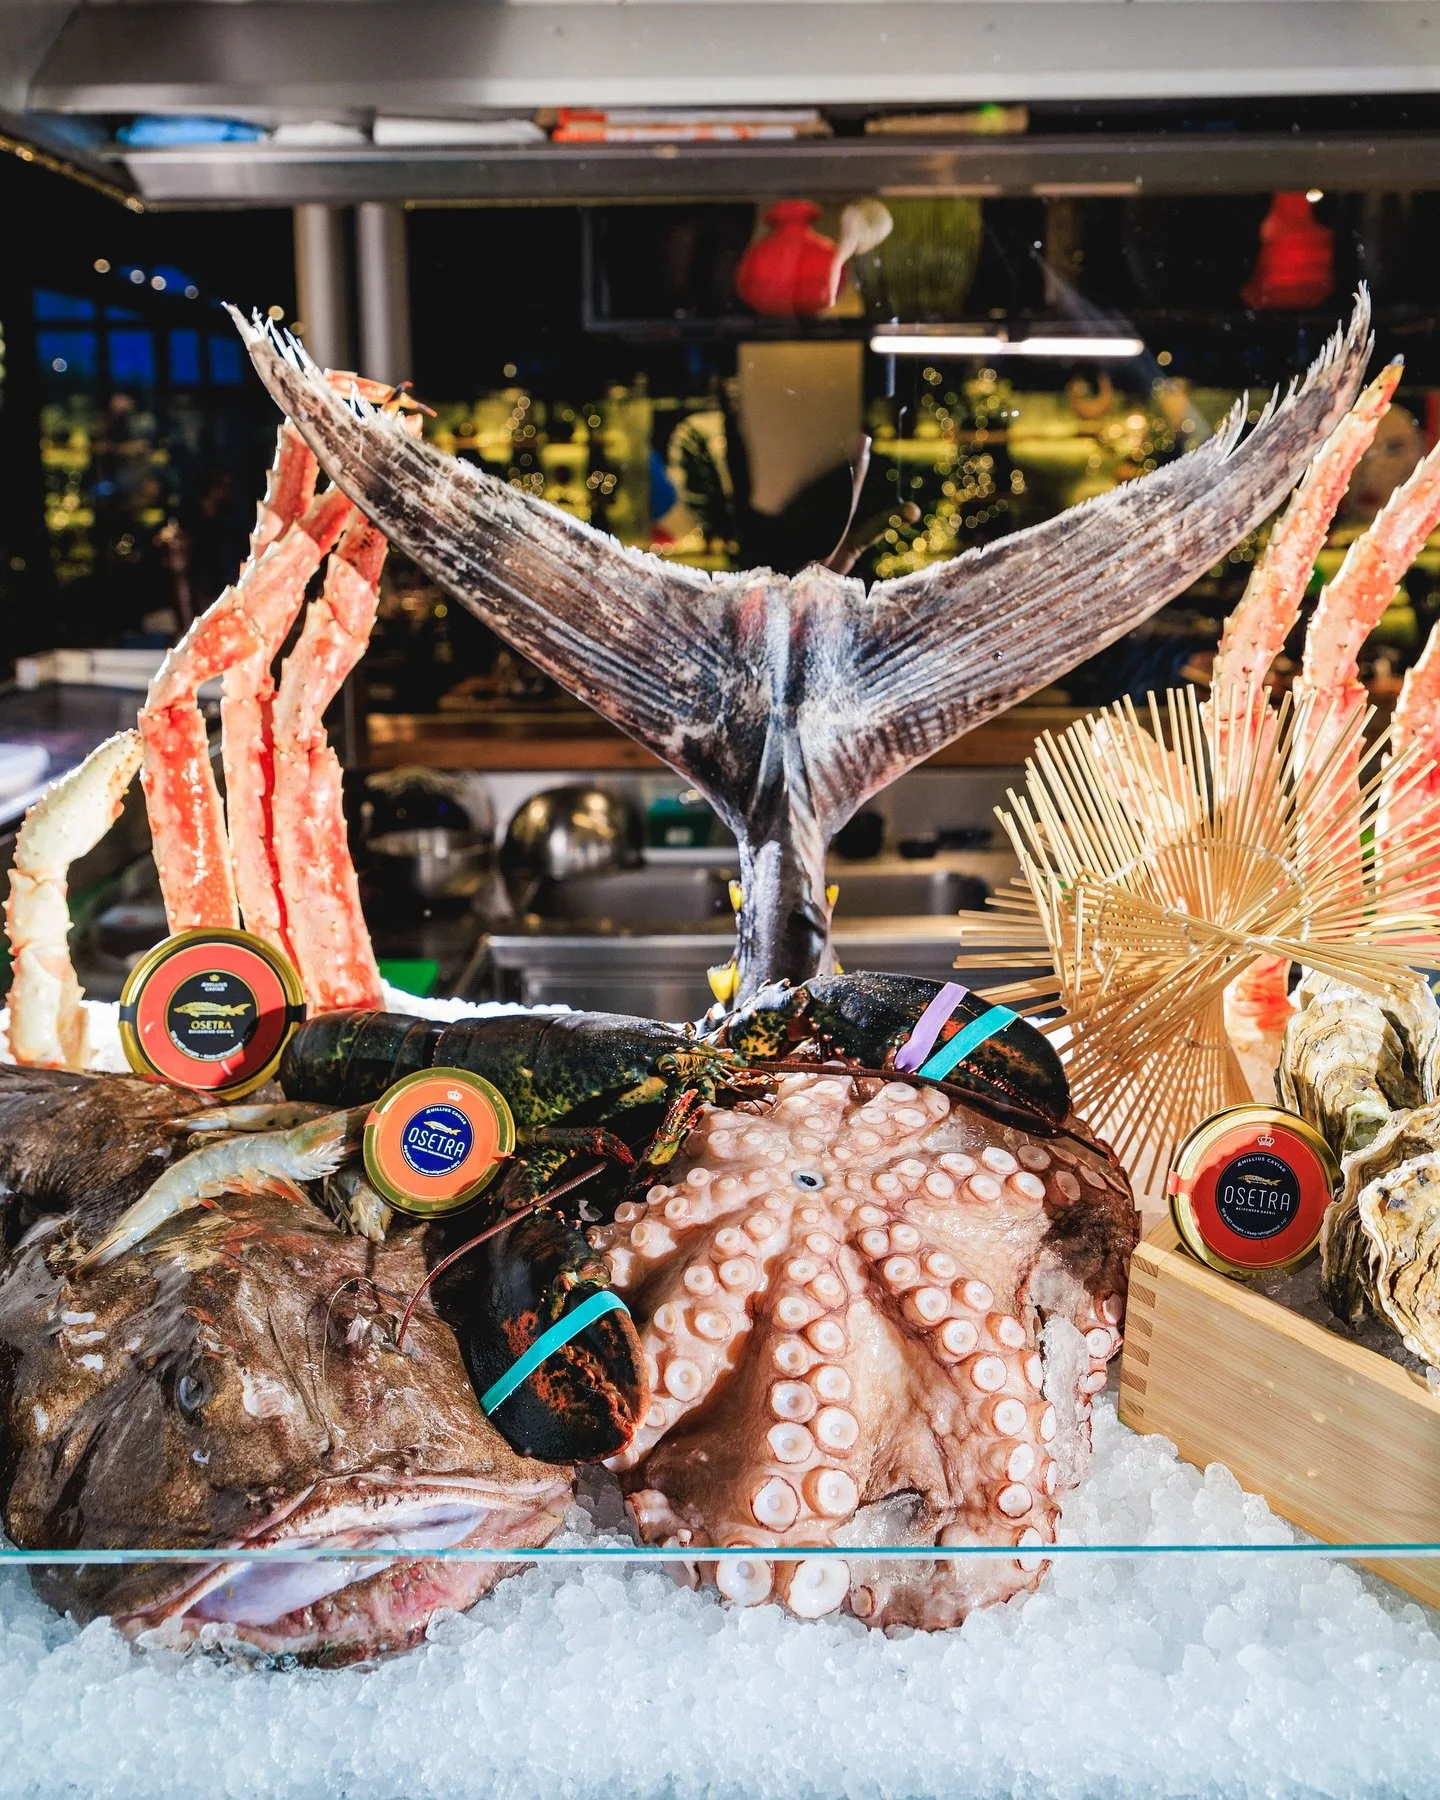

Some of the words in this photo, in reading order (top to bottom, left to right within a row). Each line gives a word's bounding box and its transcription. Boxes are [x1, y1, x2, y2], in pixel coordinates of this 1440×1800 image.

[190, 1020, 232, 1030] OSETRA
[452, 1110, 467, 1125] CAVIAR
[408, 1127, 466, 1158] OSETRA
[1266, 1158, 1287, 1173] CAVIAR
[1224, 1185, 1291, 1212] OSETRA
